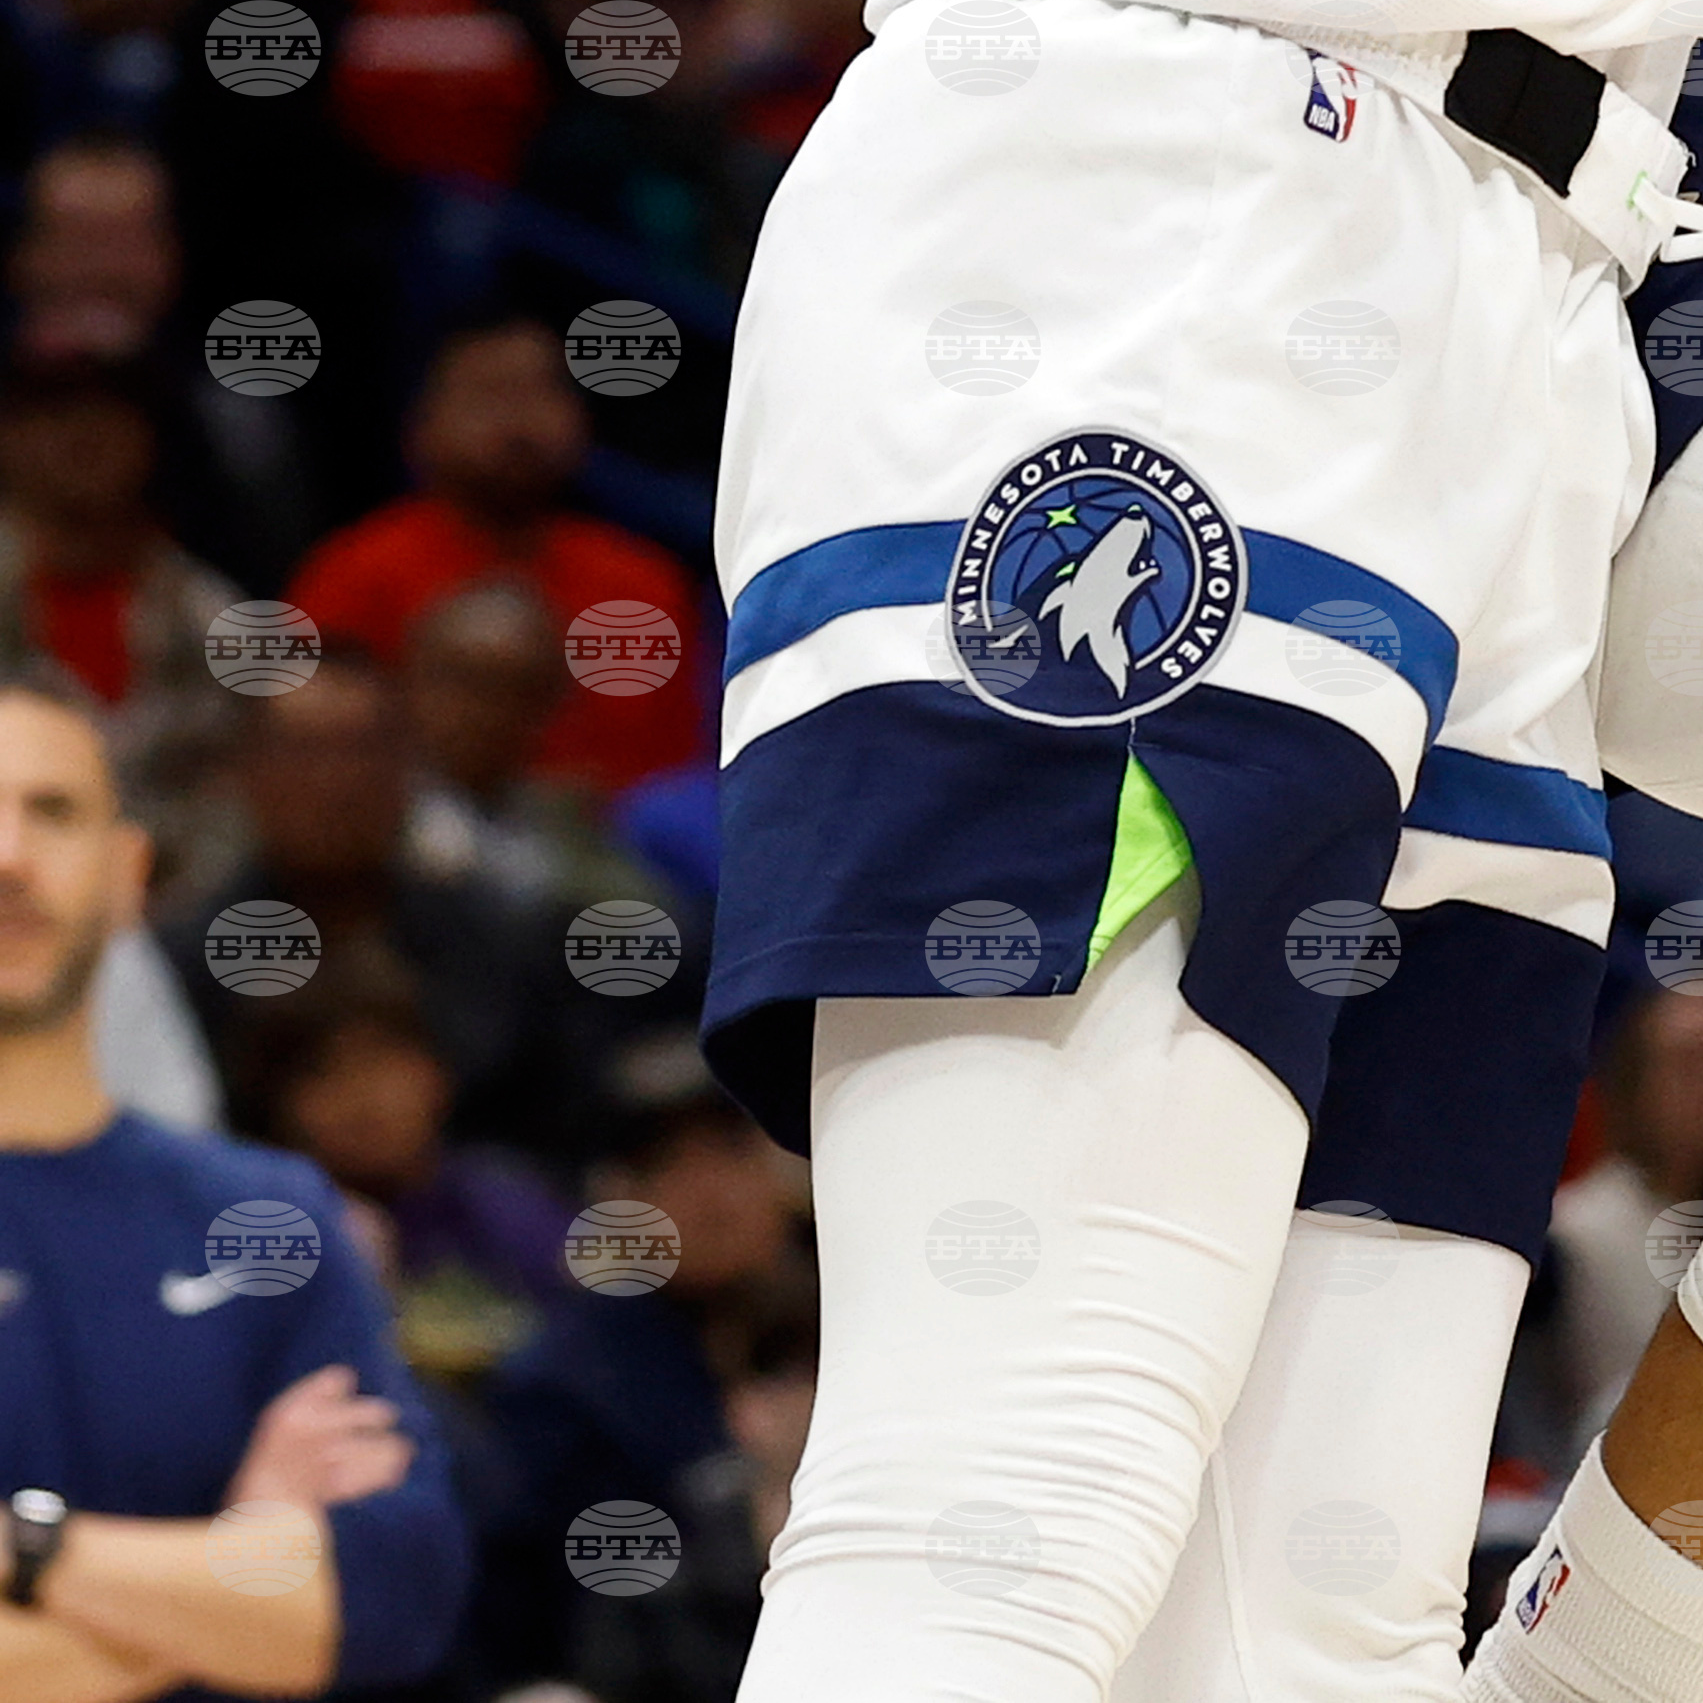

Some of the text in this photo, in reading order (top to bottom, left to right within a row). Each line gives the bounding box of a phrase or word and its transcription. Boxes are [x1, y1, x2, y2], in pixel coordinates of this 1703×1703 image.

[1307, 102, 1337, 134] NBA
[957, 441, 1234, 680] MINNESOTA TIMBERWOLVES
